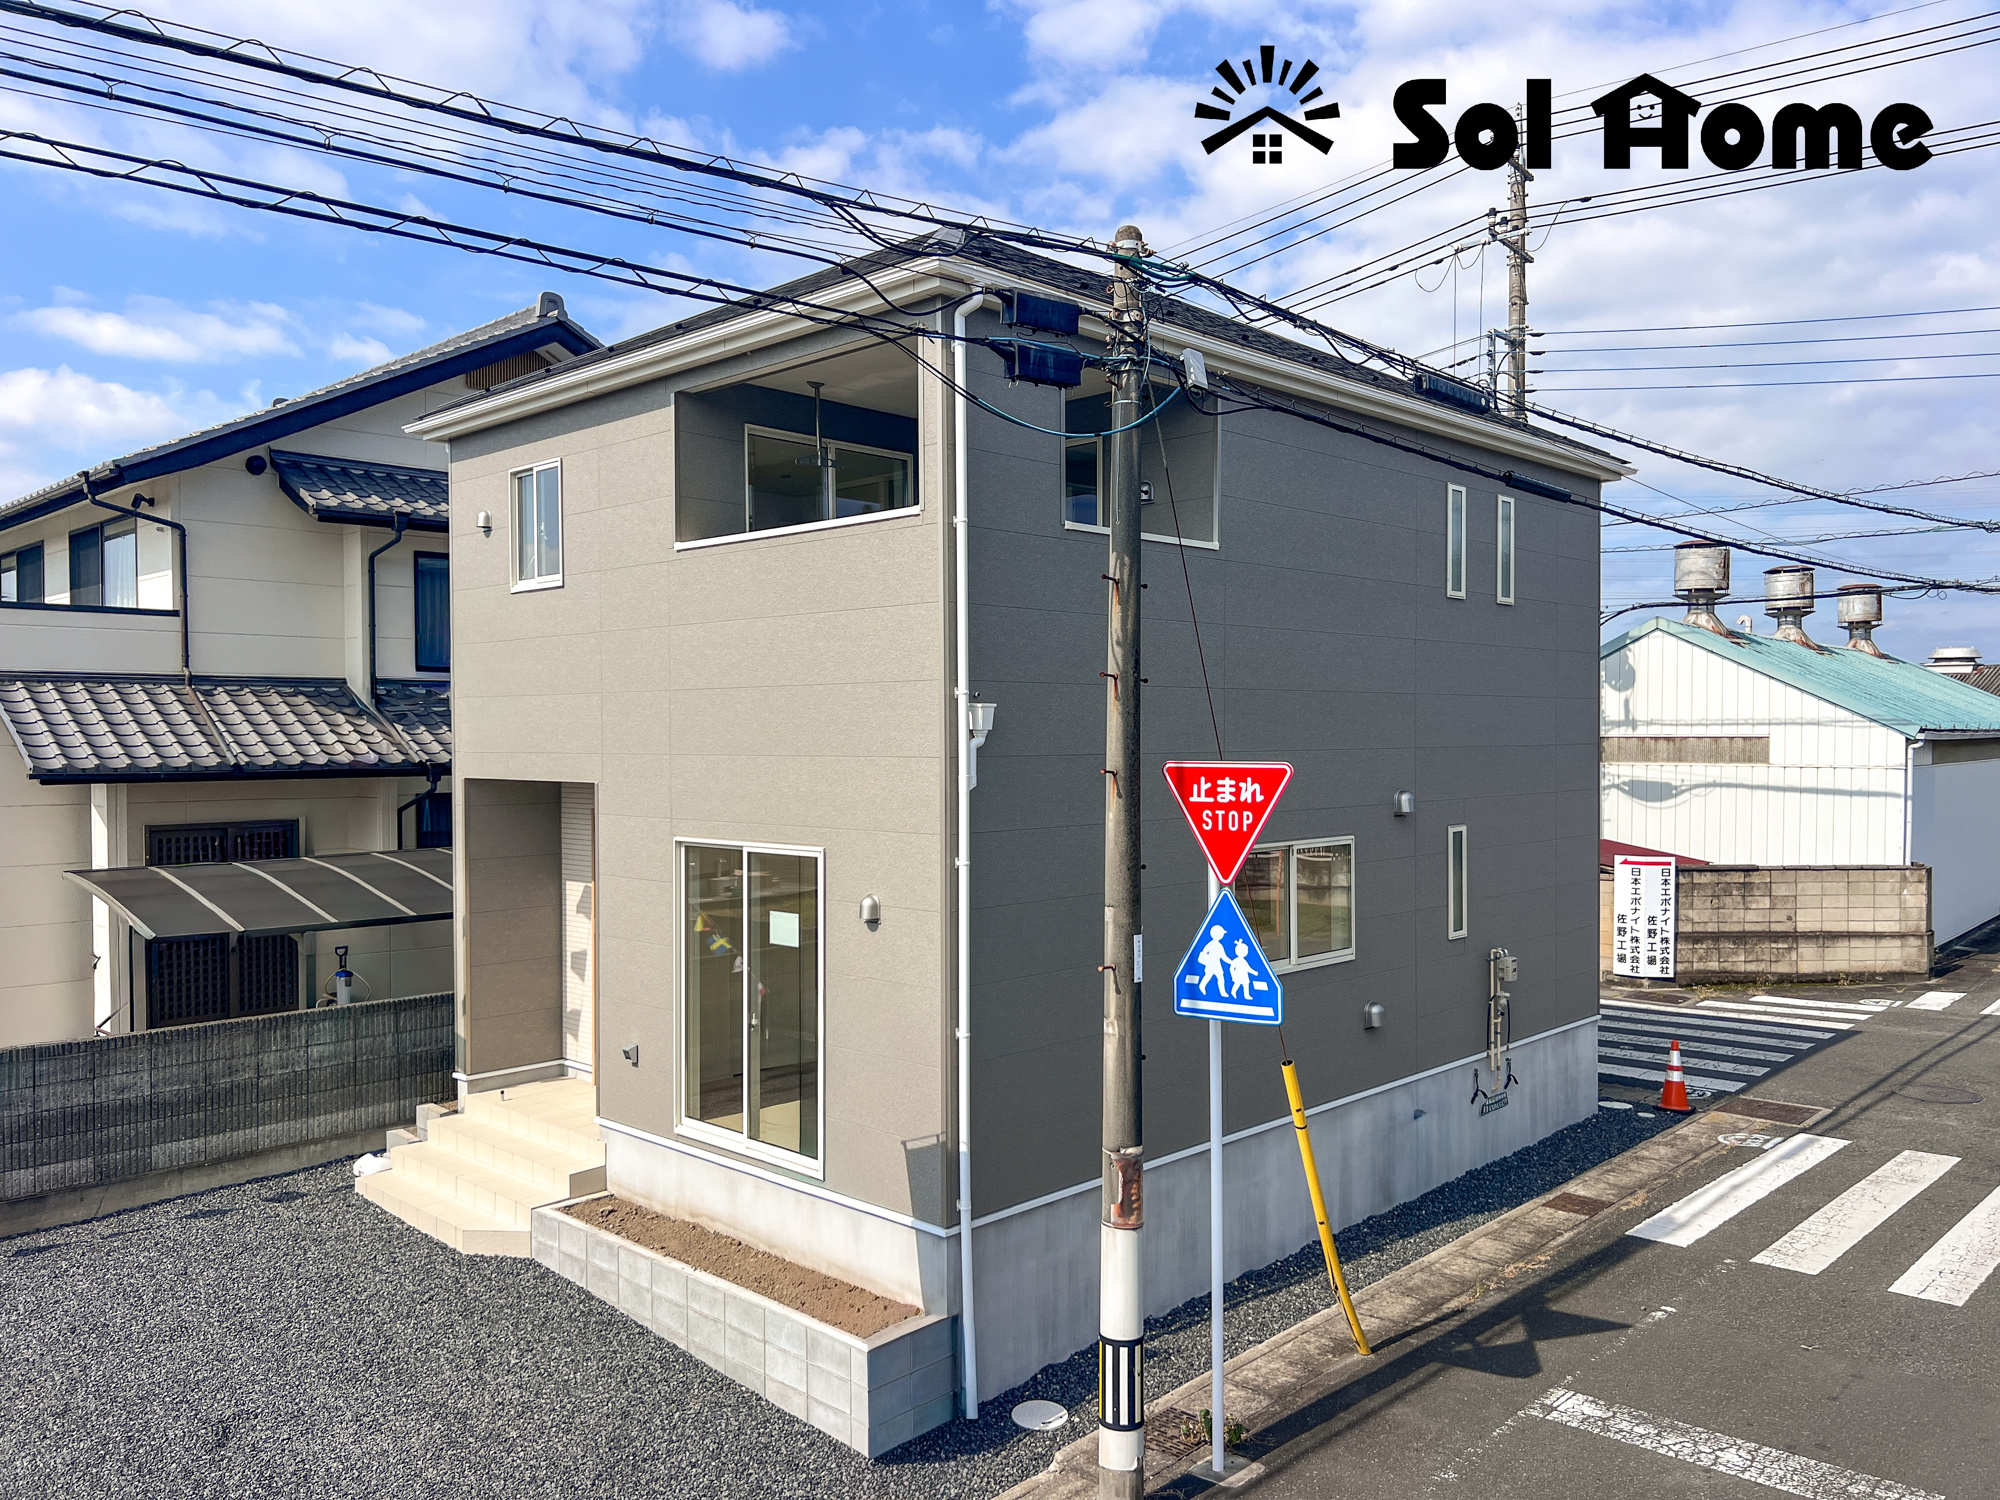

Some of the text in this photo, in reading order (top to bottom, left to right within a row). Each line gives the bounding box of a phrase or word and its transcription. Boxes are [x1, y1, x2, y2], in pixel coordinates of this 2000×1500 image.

[1188, 775, 1265, 804] 止まれ
[1202, 809, 1254, 833] STOP
[1616, 913, 1628, 964] 佐野工場
[1629, 867, 1642, 974] 日本エボナイト株式会社
[1646, 915, 1658, 966] 佐野工場
[1659, 868, 1672, 975] 日本エボナイト株式会社
